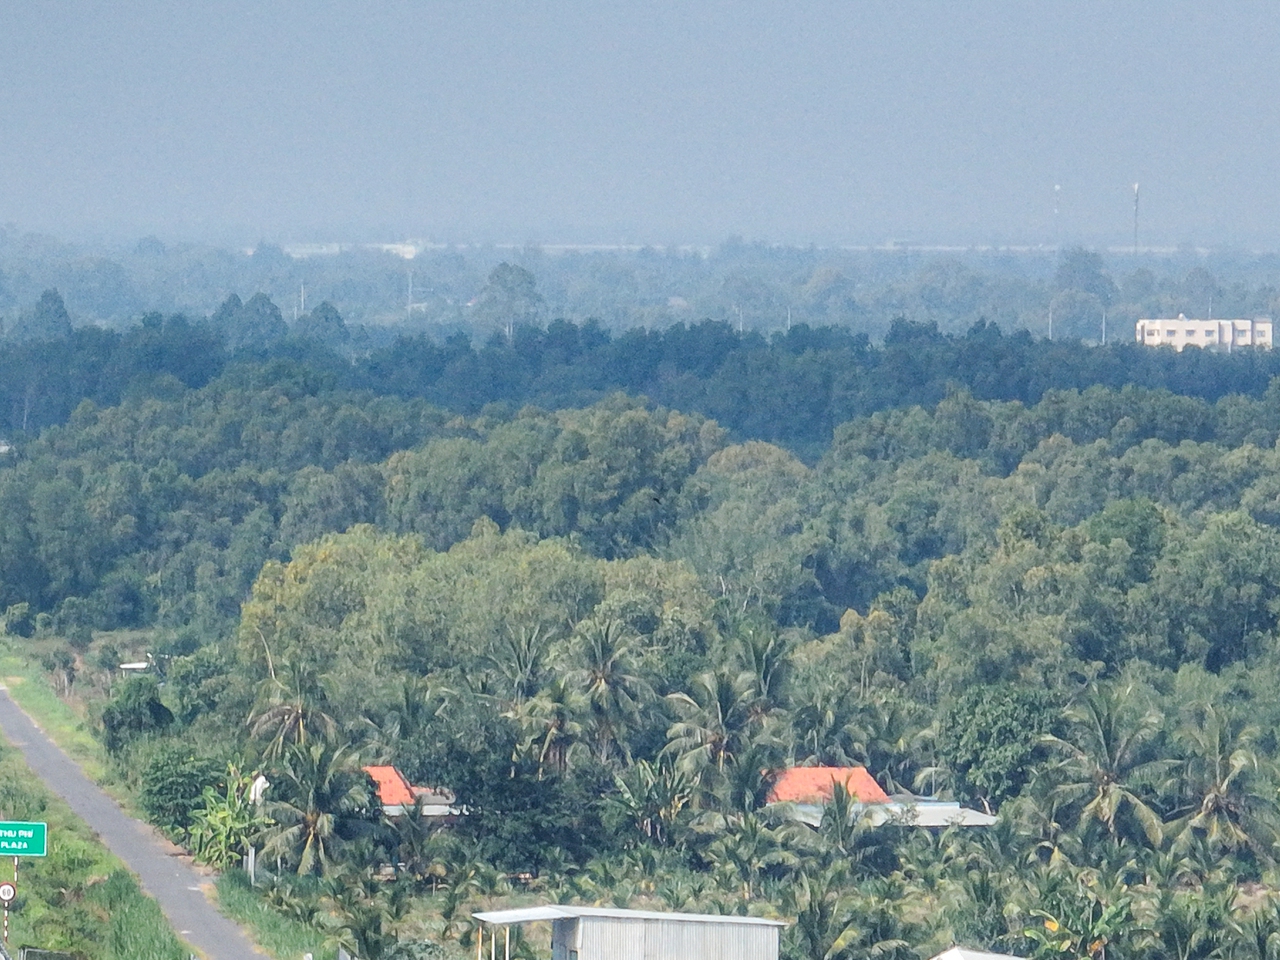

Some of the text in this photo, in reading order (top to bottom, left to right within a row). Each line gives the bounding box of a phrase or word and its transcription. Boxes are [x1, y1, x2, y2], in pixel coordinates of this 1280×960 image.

[0, 829, 17, 838] THU
[18, 829, 34, 838] PHÍ
[1, 841, 28, 849] PLAZA
[2, 888, 12, 897] 60
